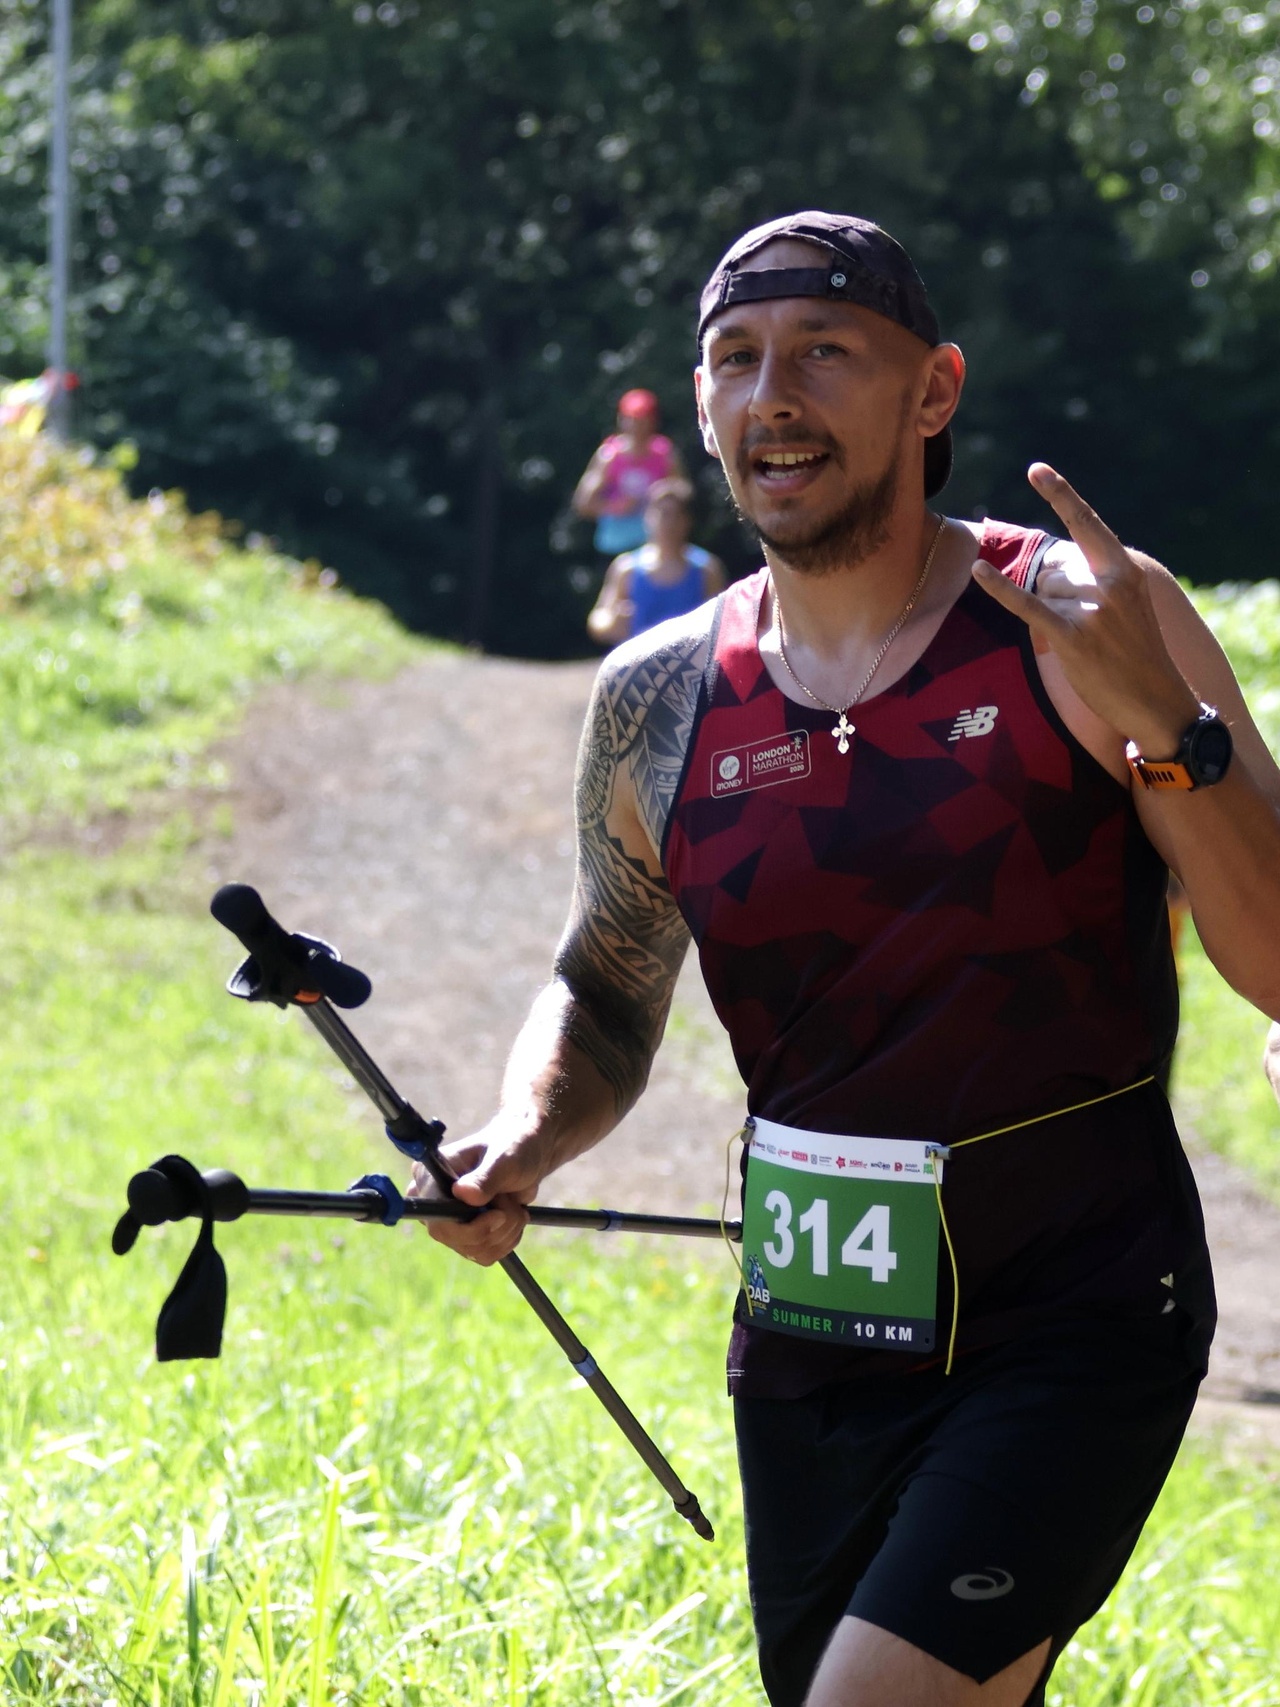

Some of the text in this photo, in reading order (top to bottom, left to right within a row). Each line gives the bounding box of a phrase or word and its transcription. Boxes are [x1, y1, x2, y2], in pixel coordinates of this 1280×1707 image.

[752, 744, 791, 763] LONDON
[752, 751, 804, 772] MARATHON
[716, 778, 743, 792] MONEY
[763, 1189, 897, 1283] 314
[773, 1308, 832, 1332] SUMMER
[854, 1322, 875, 1338] 10
[885, 1325, 912, 1342] KM
